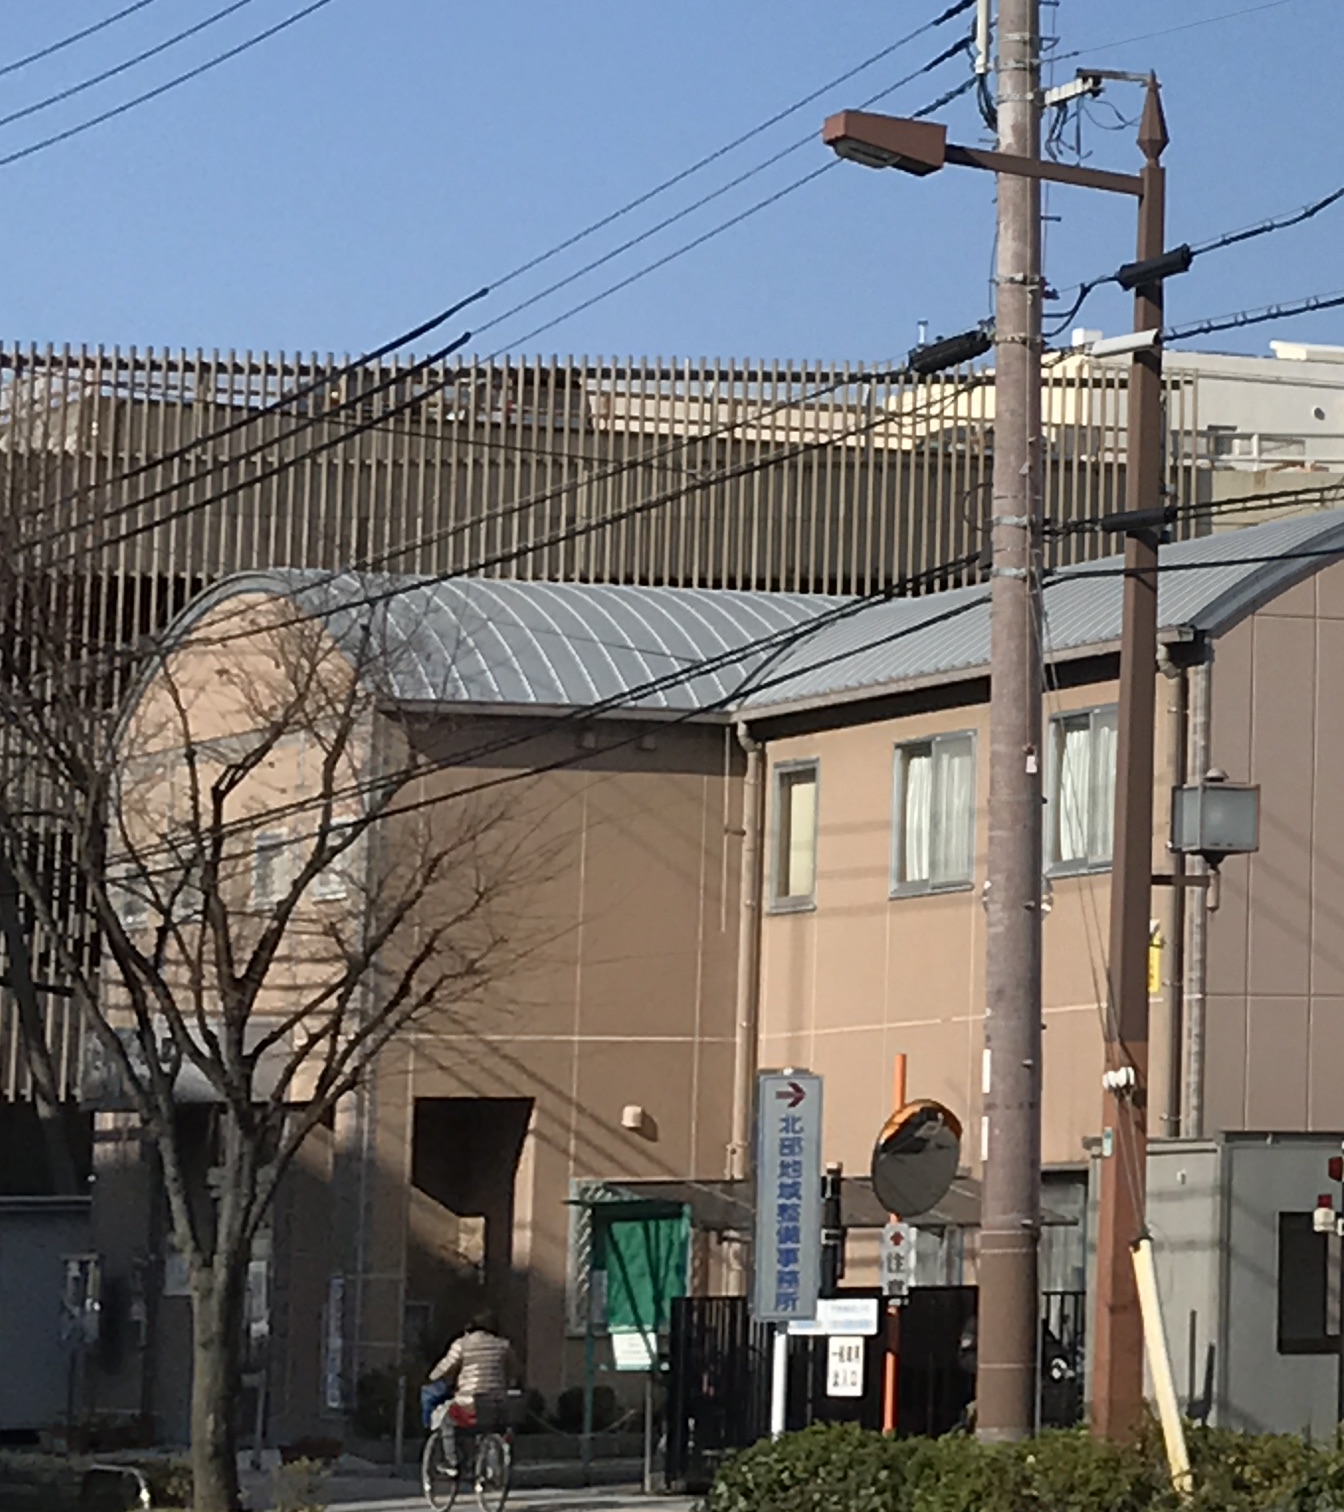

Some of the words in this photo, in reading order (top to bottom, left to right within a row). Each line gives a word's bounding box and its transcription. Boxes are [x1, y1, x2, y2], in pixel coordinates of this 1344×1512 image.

[774, 1114, 804, 1312] 北部地域整備事務所
